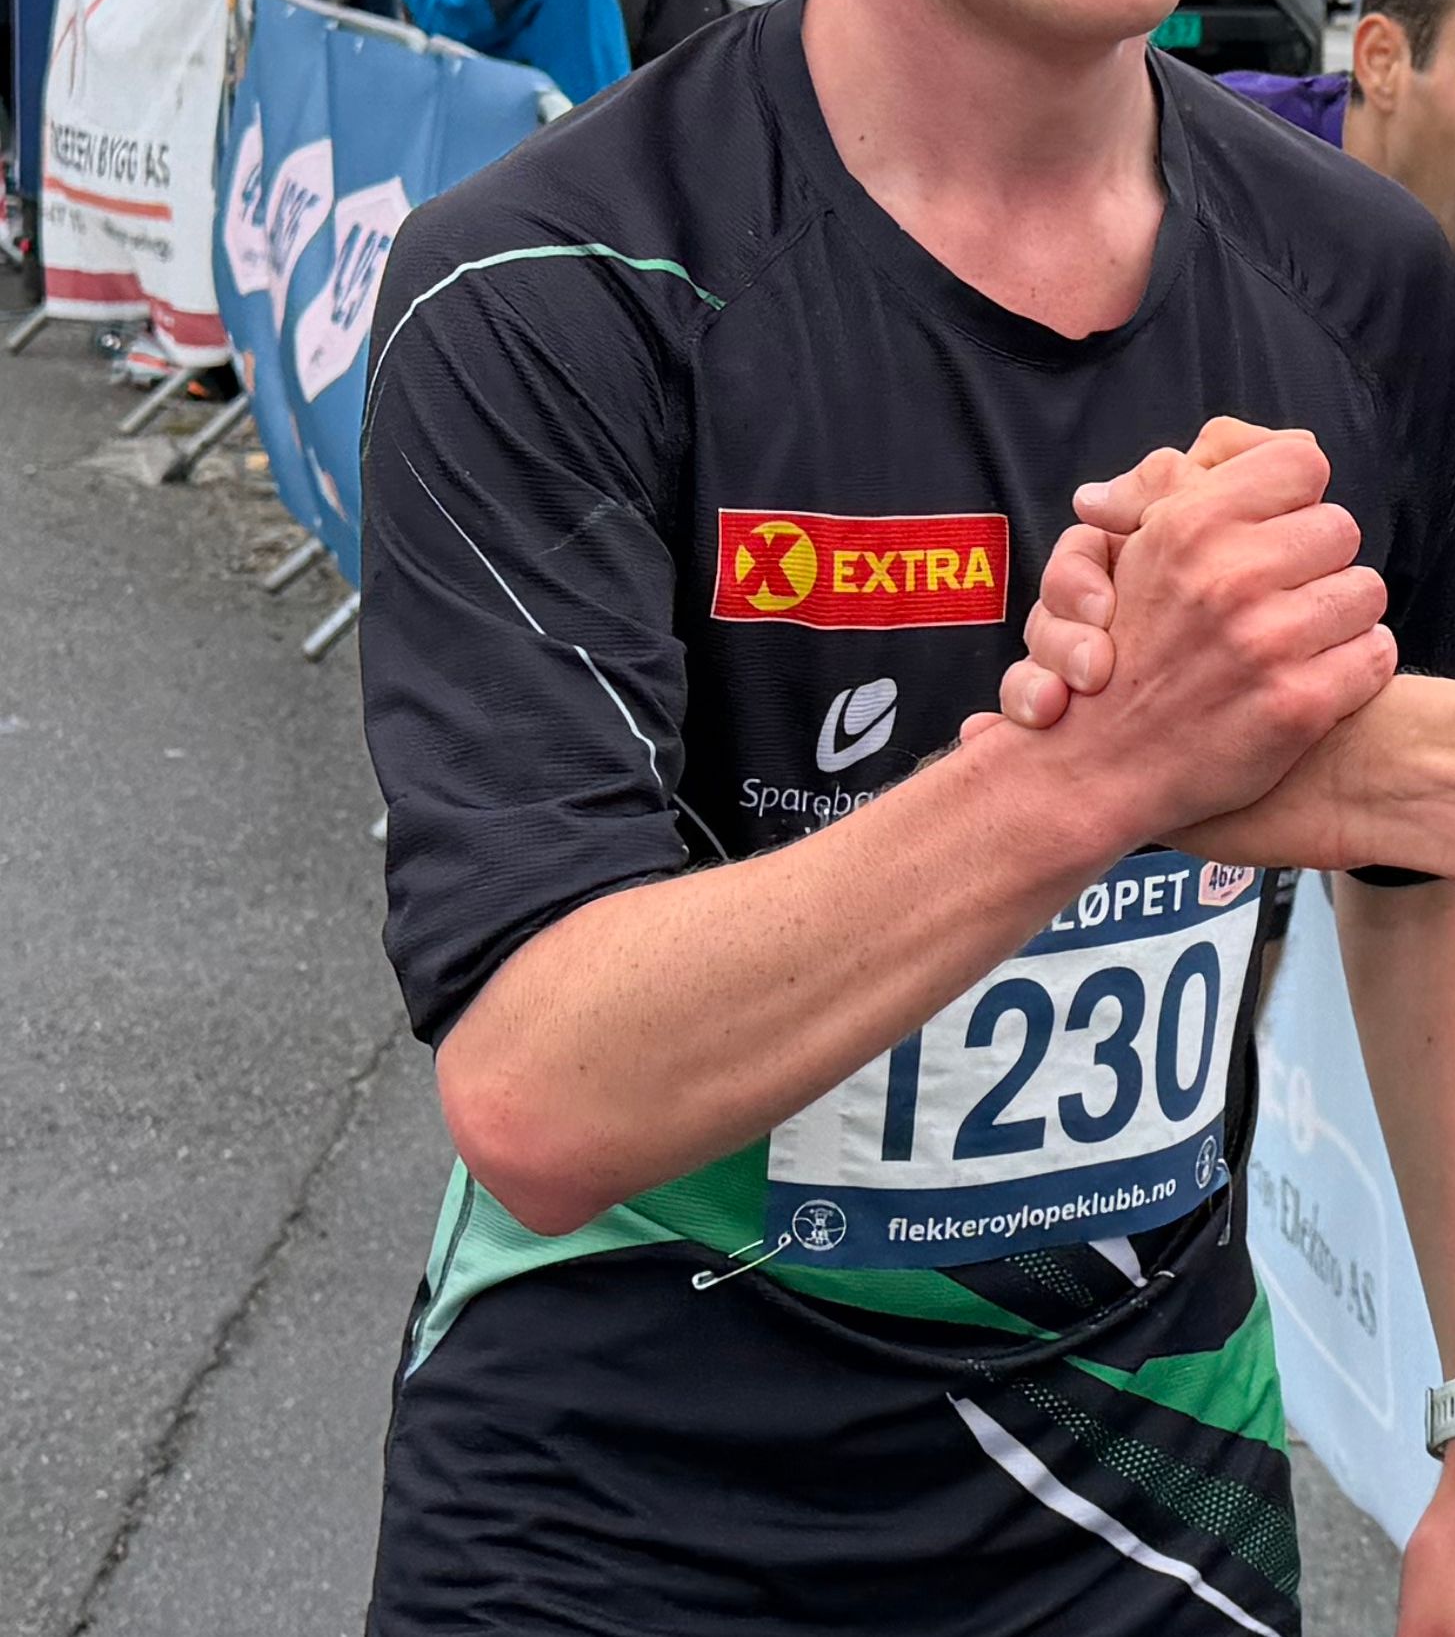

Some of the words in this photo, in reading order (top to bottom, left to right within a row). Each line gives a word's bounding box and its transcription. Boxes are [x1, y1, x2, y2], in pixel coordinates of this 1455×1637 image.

[833, 547, 995, 594] EXTRA
[882, 941, 1221, 1162] 1230
[888, 1176, 1177, 1242] flekkeroylopeklubb.no
